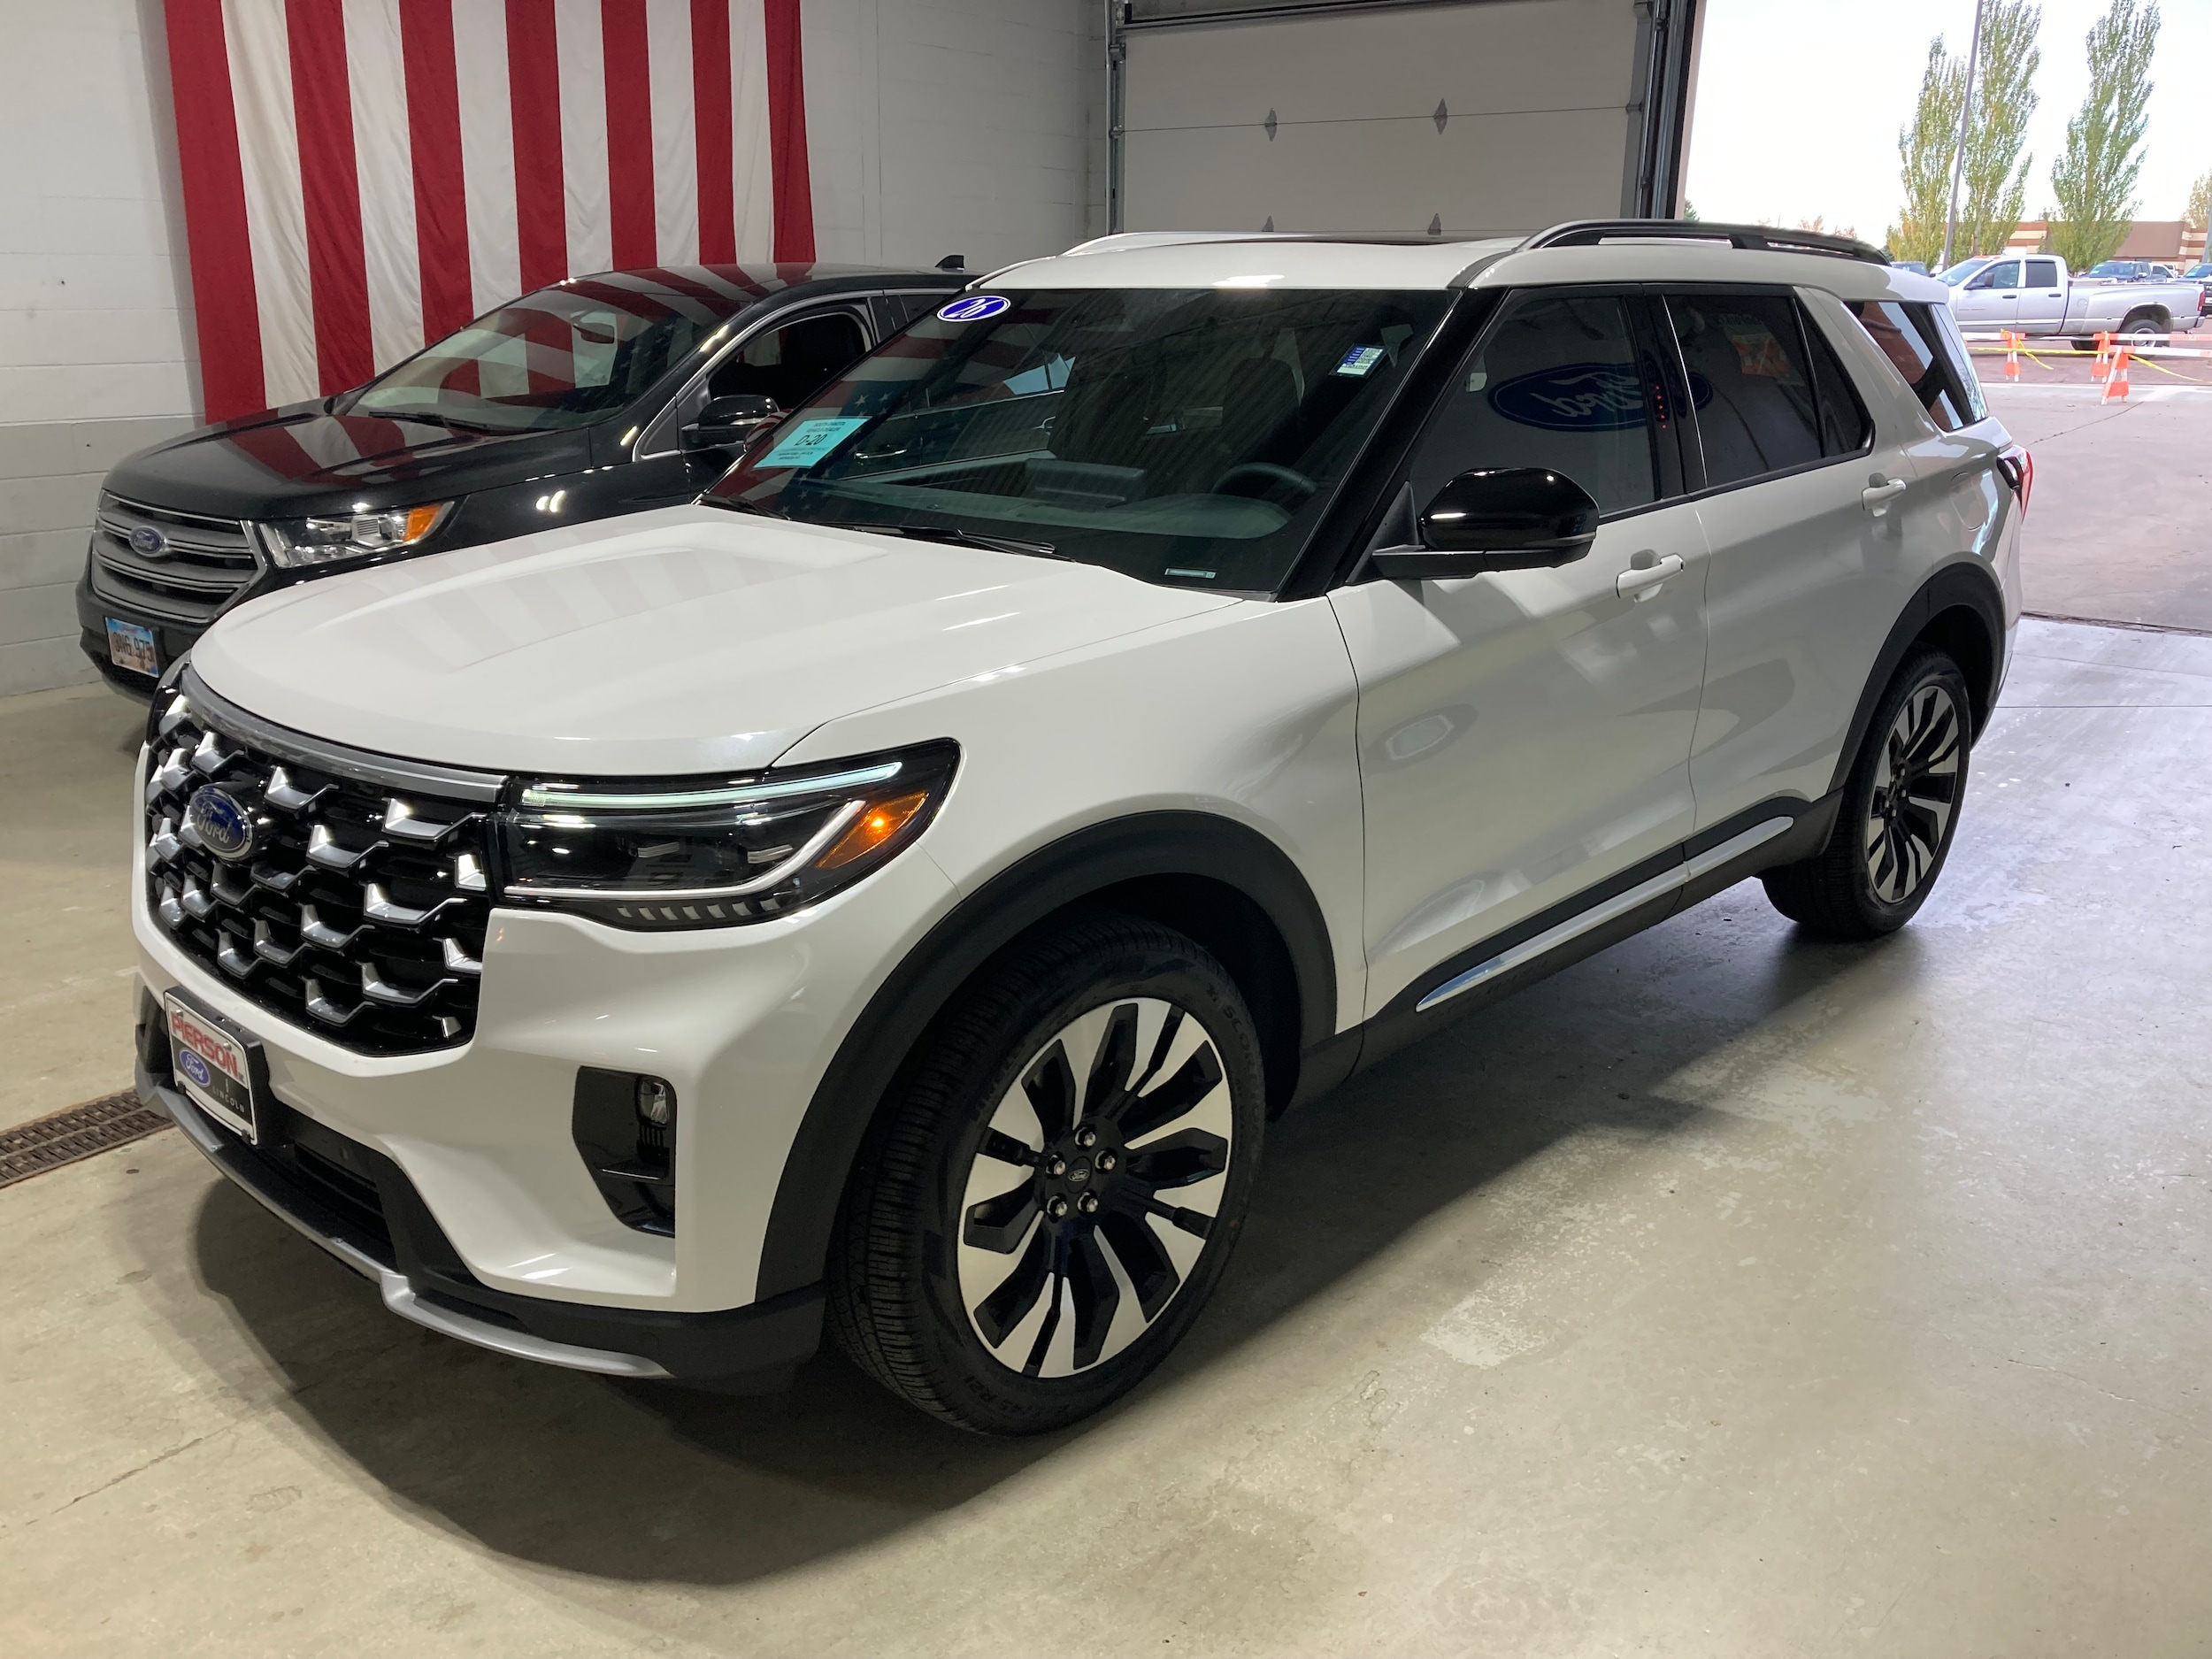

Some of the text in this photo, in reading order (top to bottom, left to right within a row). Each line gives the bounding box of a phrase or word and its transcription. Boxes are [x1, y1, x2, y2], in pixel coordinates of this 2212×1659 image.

[795, 434, 828, 446] D-20
[134, 530, 156, 549] Ford
[196, 800, 230, 844] Ford
[171, 1013, 239, 1079] PIERSON
[185, 1053, 204, 1081] Ford
[212, 1085, 245, 1113] LINCOLN
